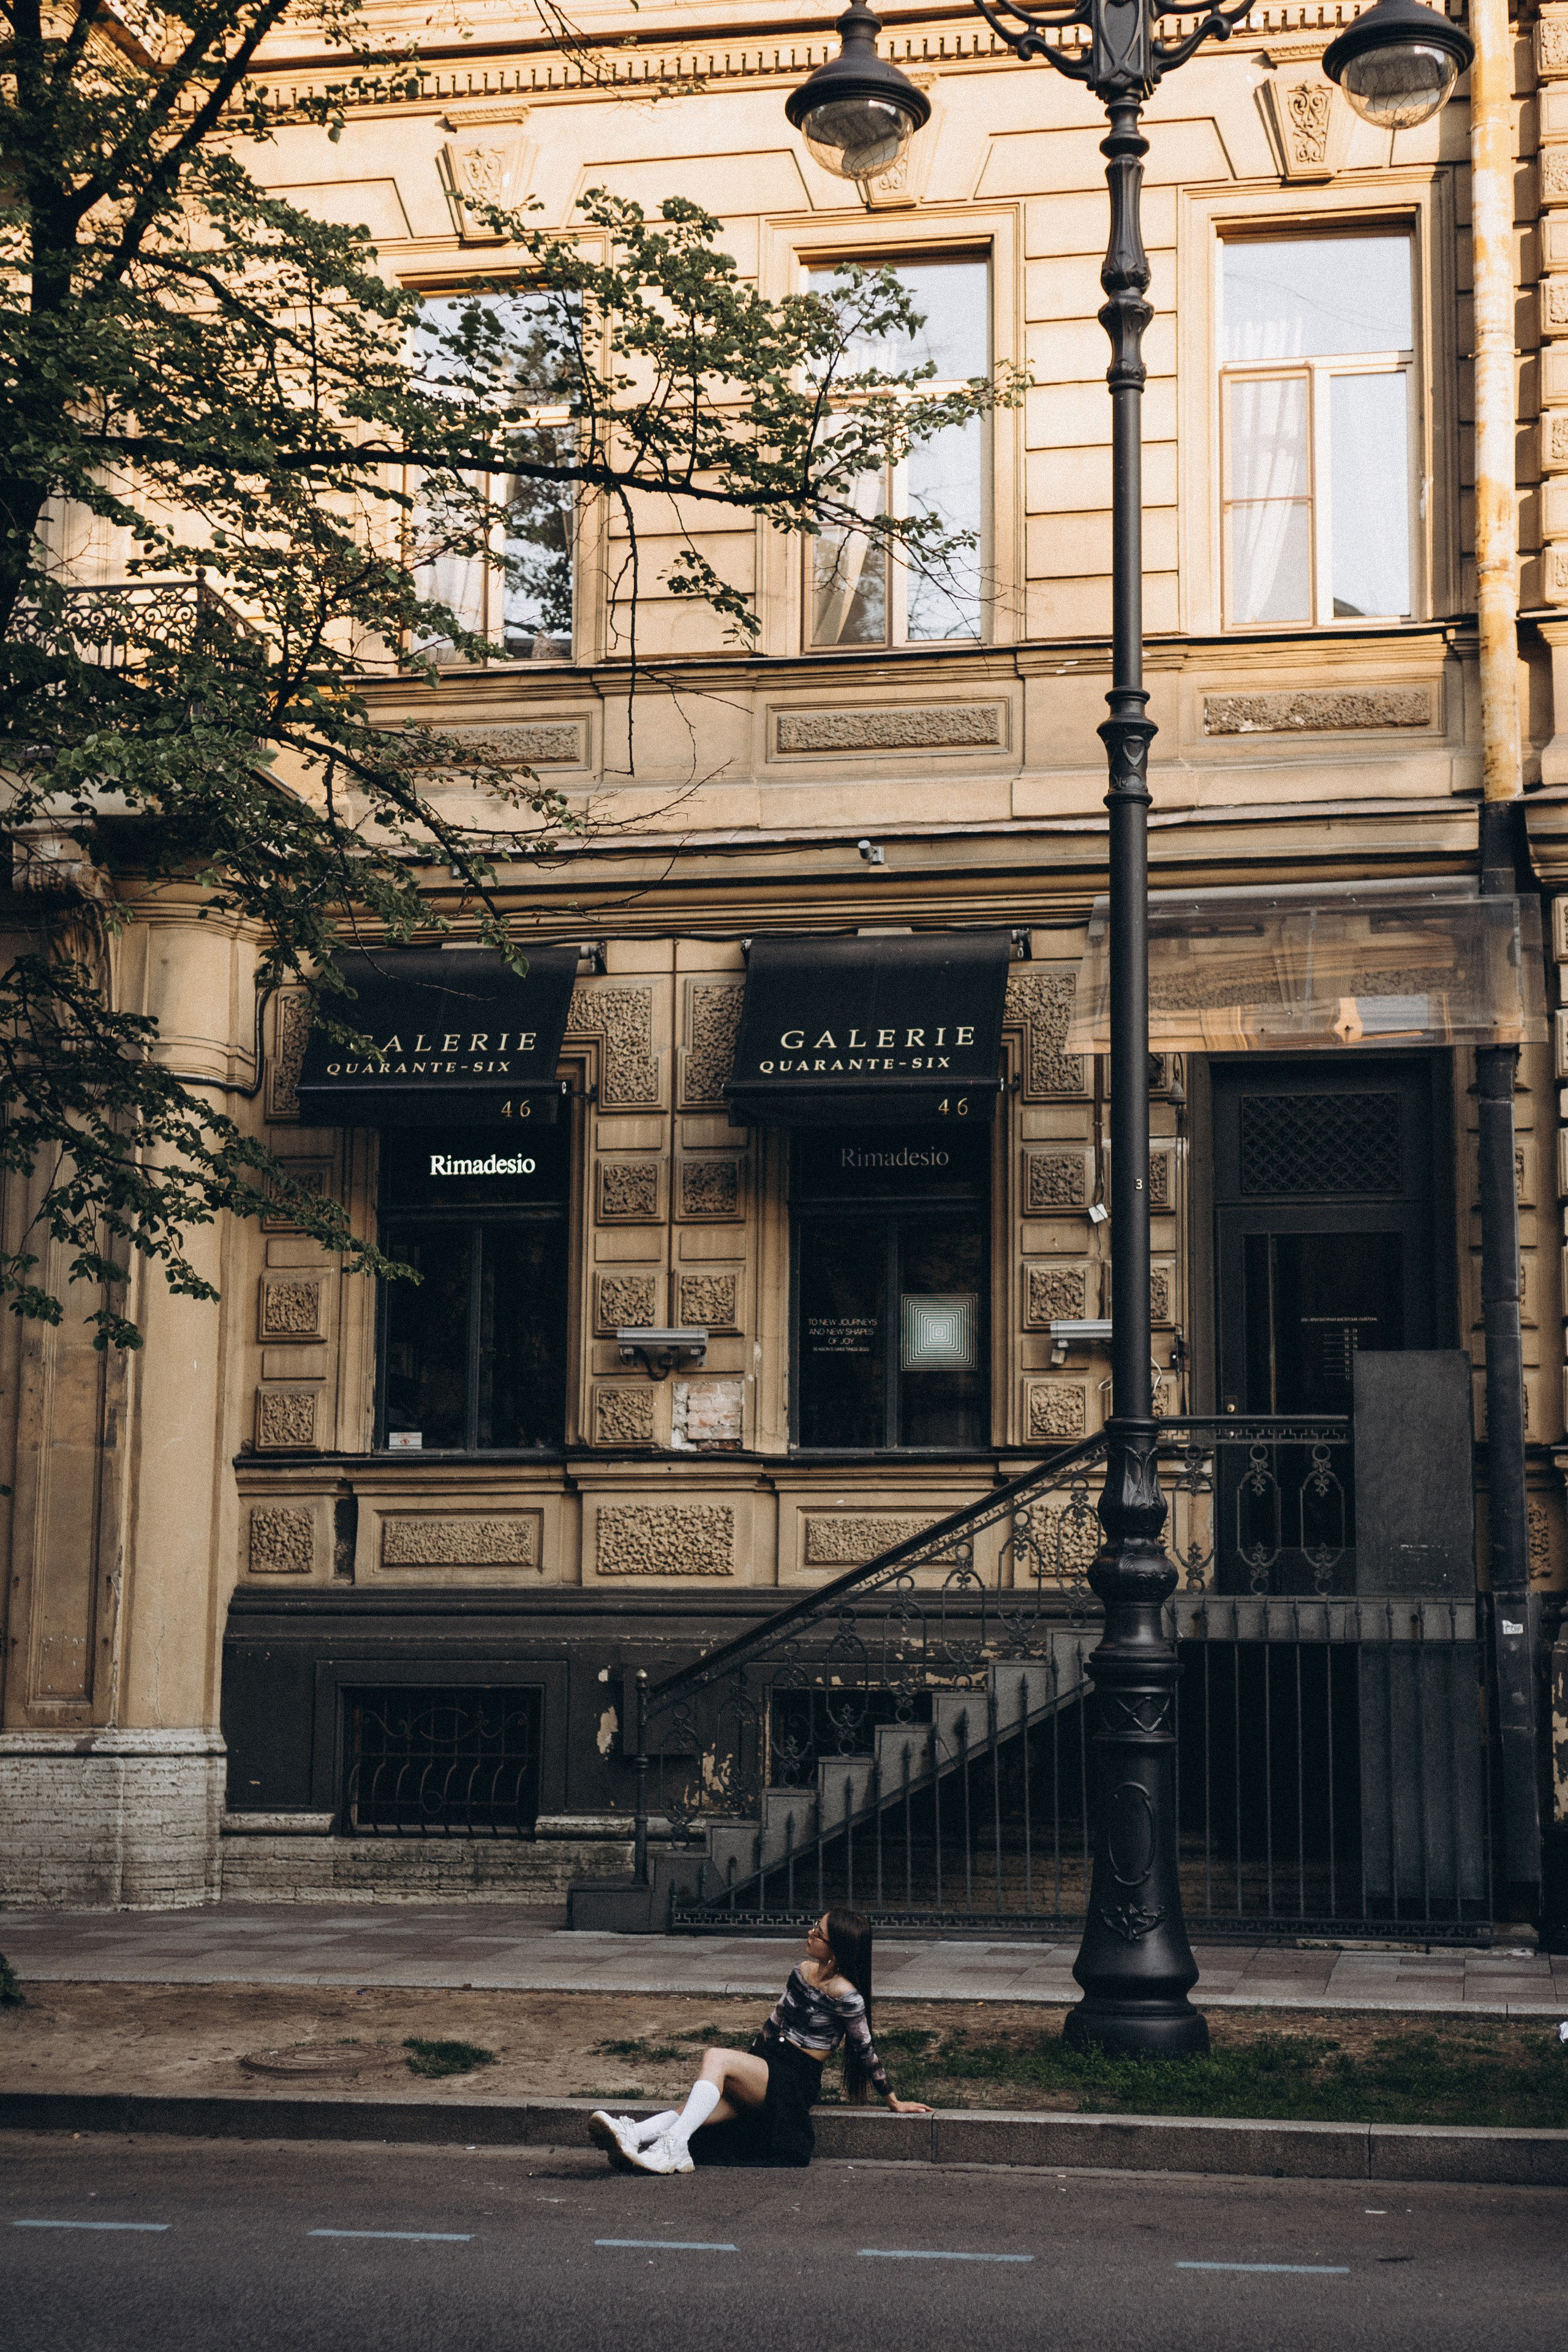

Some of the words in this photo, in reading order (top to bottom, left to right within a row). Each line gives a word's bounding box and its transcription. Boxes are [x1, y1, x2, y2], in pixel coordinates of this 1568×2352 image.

[350, 1032, 537, 1052] ALERIE
[780, 1026, 975, 1049] GALERIE
[326, 1061, 511, 1076] QUARANTE-SIX
[759, 1057, 951, 1074] QUARANTE-SIX
[501, 1100, 531, 1117] 46
[938, 1098, 968, 1115] 46
[430, 1153, 536, 1175] Rimadesio
[840, 1146, 949, 1167] Rimadesio
[1136, 1178, 1143, 1189] 3
